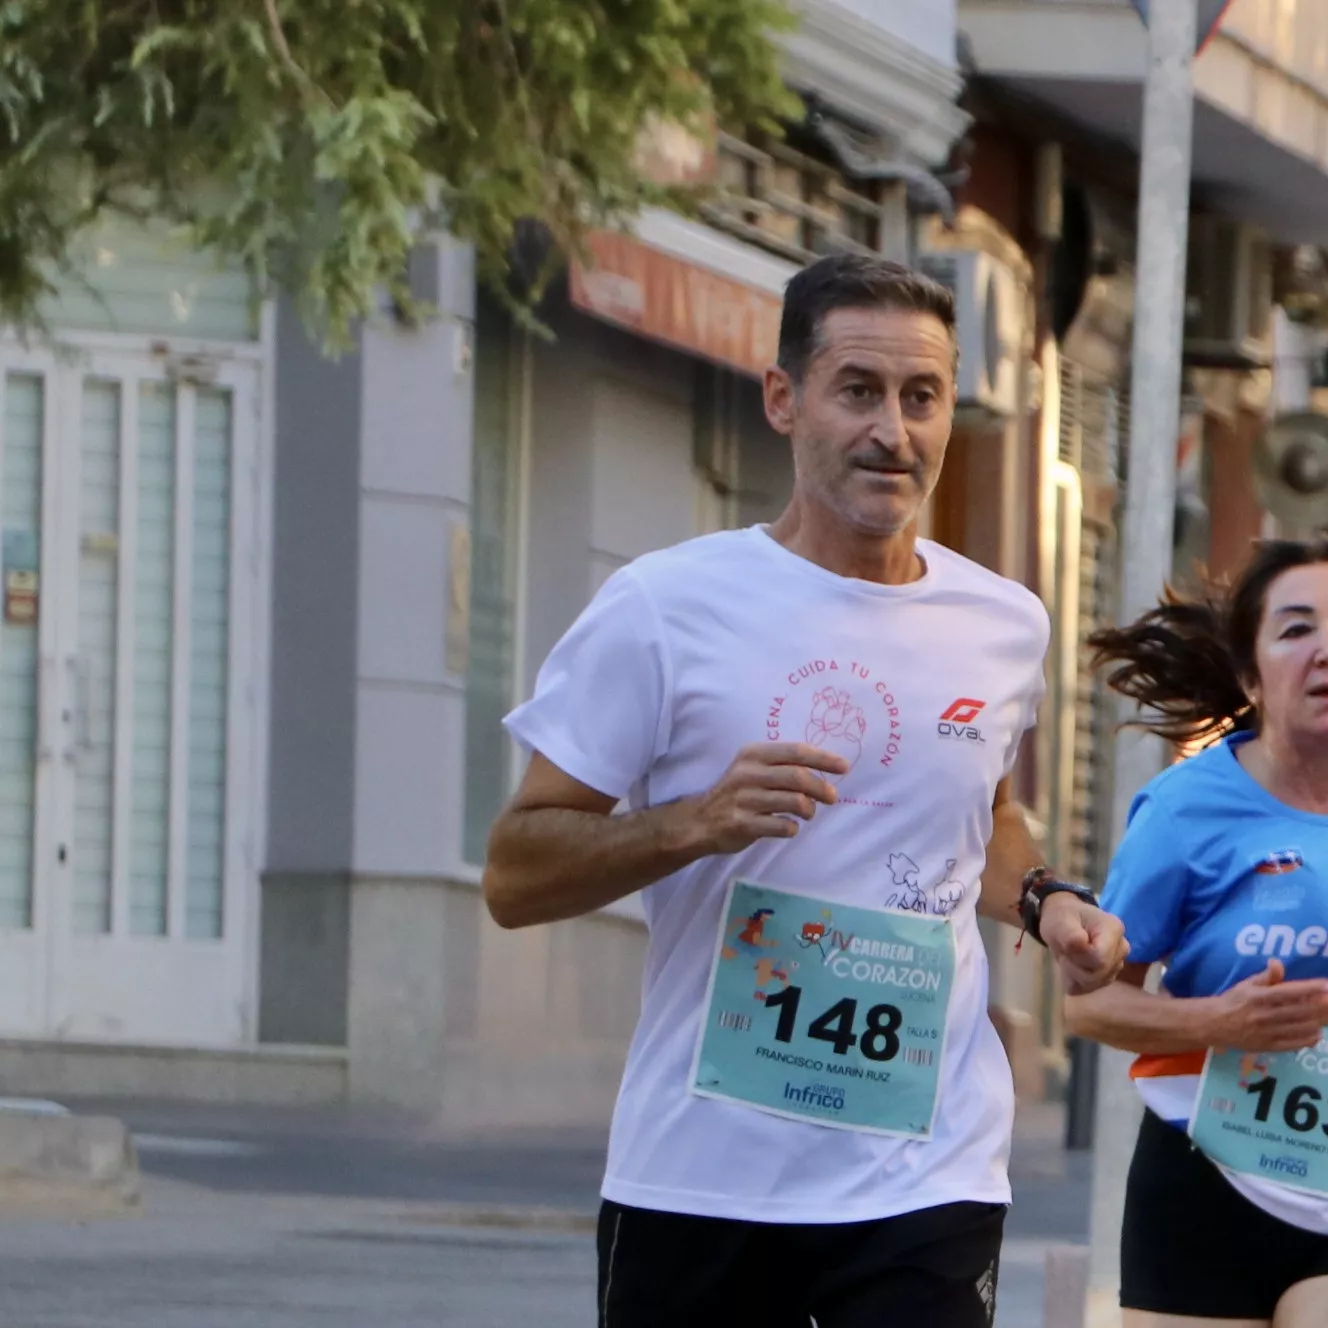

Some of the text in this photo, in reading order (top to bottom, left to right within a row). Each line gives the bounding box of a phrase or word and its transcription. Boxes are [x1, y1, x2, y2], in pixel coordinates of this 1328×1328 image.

[788, 660, 838, 685] CUIDA
[851, 662, 869, 679] TU
[876, 681, 901, 766] CORAZÓN
[831, 930, 854, 951] IV
[850, 937, 914, 962] CARRERA
[765, 986, 903, 1062] 148
[755, 1046, 891, 1082] FRANCISCO MARIN RUIZ
[784, 1082, 844, 1110] Infrico
[1285, 1137, 1326, 1153] MORENO
[1259, 1153, 1308, 1178] Infrico
